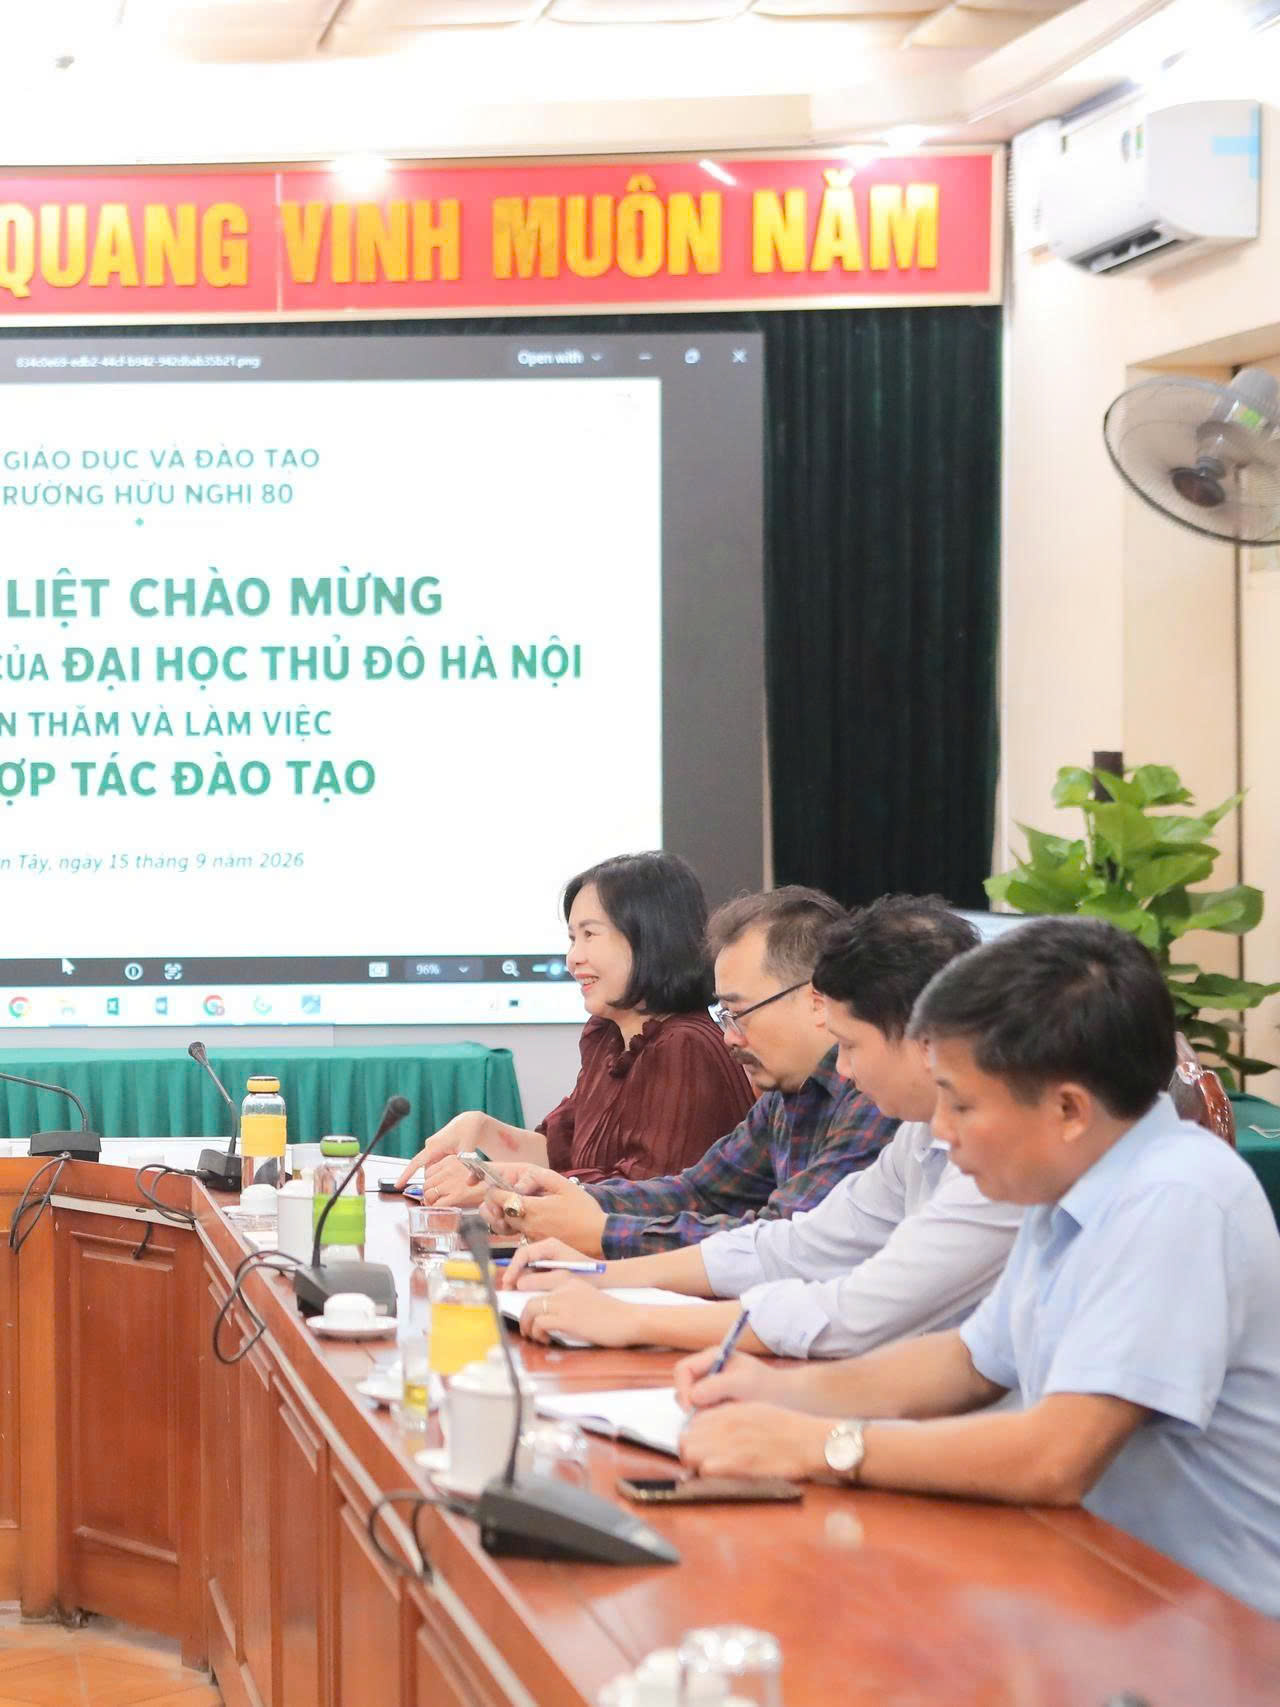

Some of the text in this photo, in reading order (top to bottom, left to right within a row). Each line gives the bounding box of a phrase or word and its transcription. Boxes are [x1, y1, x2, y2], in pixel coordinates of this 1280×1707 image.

[280, 198, 460, 284] VINH
[493, 174, 721, 278] MUÔN
[753, 168, 938, 273] NĂM
[518, 348, 583, 367] Open with
[4, 445, 71, 470] GIÁO
[150, 444, 185, 469] VÀ
[195, 444, 255, 468] ĐÀO
[262, 484, 293, 504] 80
[7, 567, 110, 628] LIỆT
[130, 566, 271, 617] CHÀO
[291, 566, 442, 616] MỪNG
[62, 647, 140, 691] ĐẠI
[156, 645, 248, 690] HỌC
[261, 634, 349, 681] THỦ
[363, 636, 425, 680] ĐÔ
[441, 635, 497, 680] HÀ
[512, 635, 580, 688] NỘI
[28, 705, 120, 737] THĂM
[131, 705, 173, 736] VÀ
[186, 705, 252, 736] LÀM
[263, 704, 332, 741] VIỆC
[72, 752, 157, 796] TÁC
[171, 752, 271, 795] ĐÀO
[286, 760, 376, 803] TẠO
[109, 854, 129, 869] 15
[136, 853, 188, 872] tháng
[195, 853, 207, 869] 9
[259, 852, 304, 868] 2026
[416, 963, 440, 975] 96%
